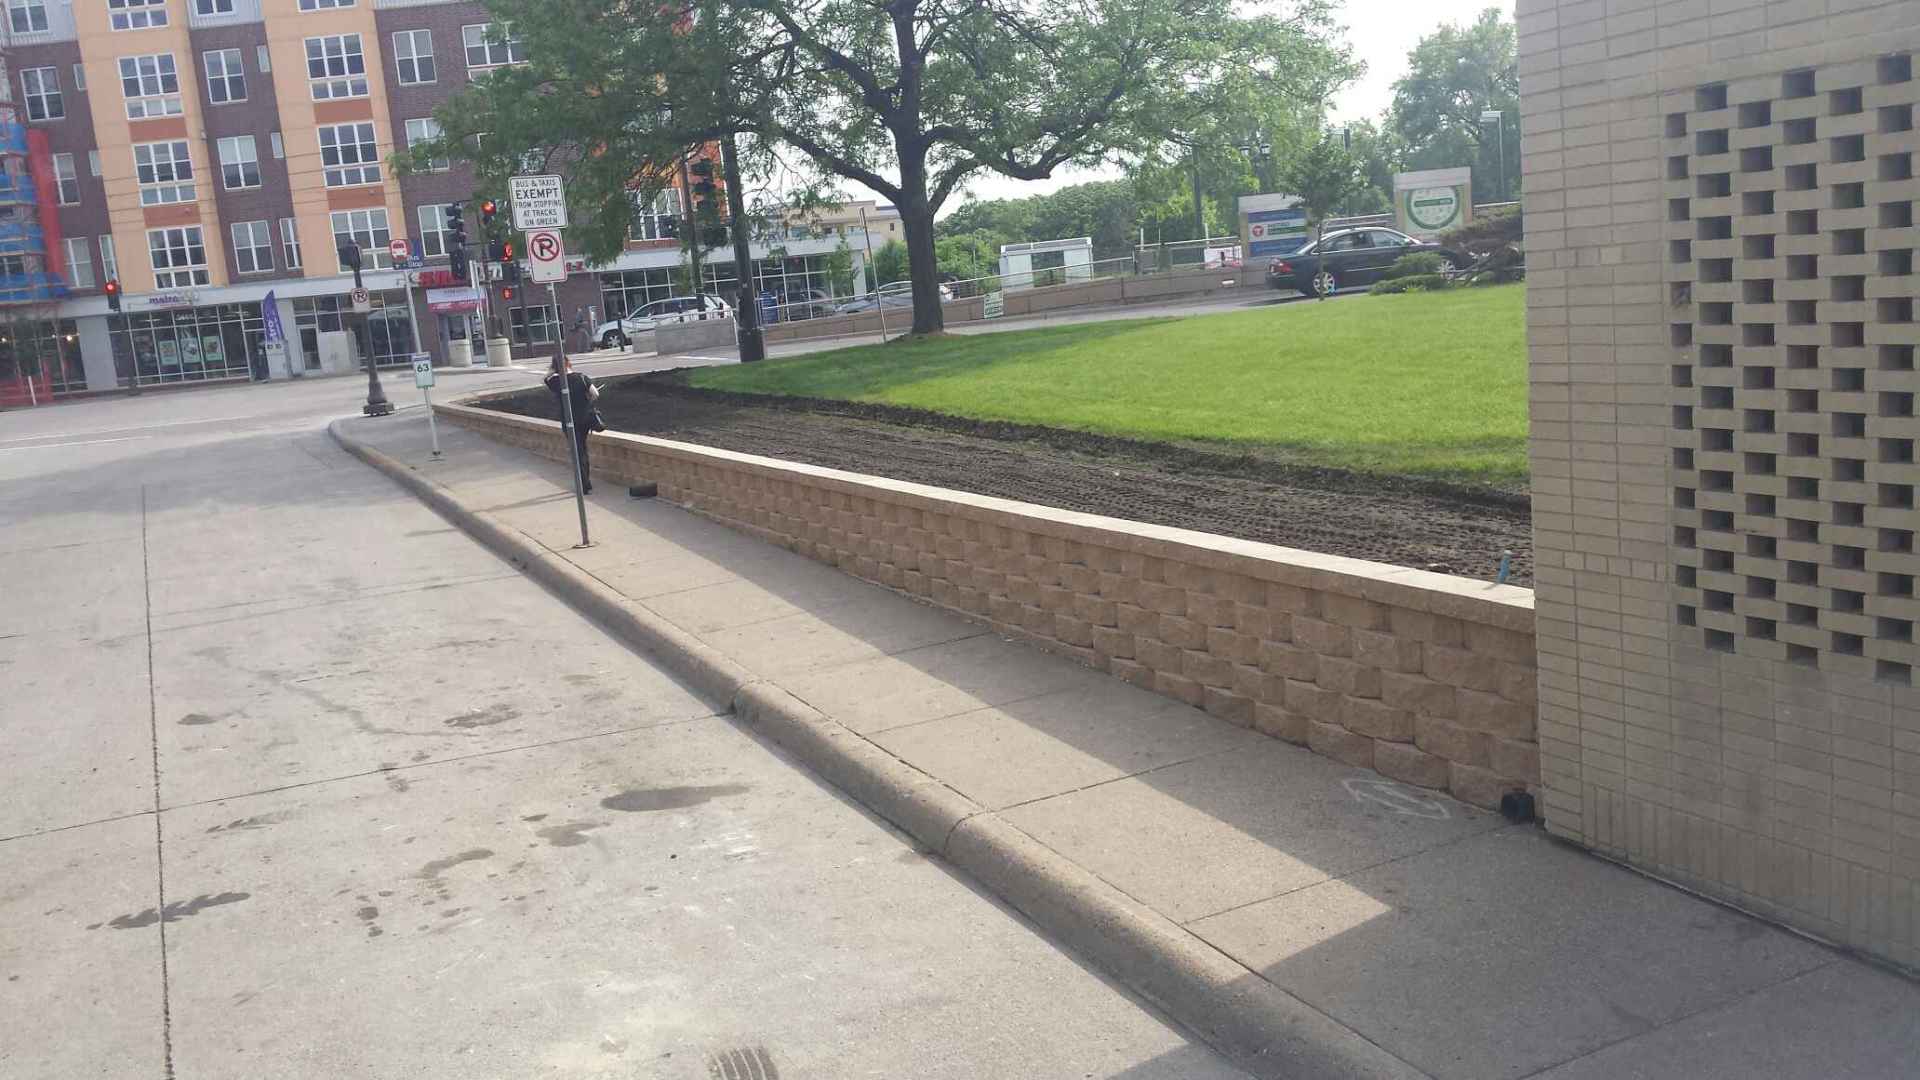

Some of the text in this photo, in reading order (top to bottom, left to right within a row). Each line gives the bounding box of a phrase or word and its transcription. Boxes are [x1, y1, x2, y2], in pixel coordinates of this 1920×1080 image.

[515, 187, 559, 199] EXEMPT
[515, 200, 562, 209] FROM STOPPING
[523, 208, 557, 217] AT TRACKS
[416, 363, 430, 373] 63
